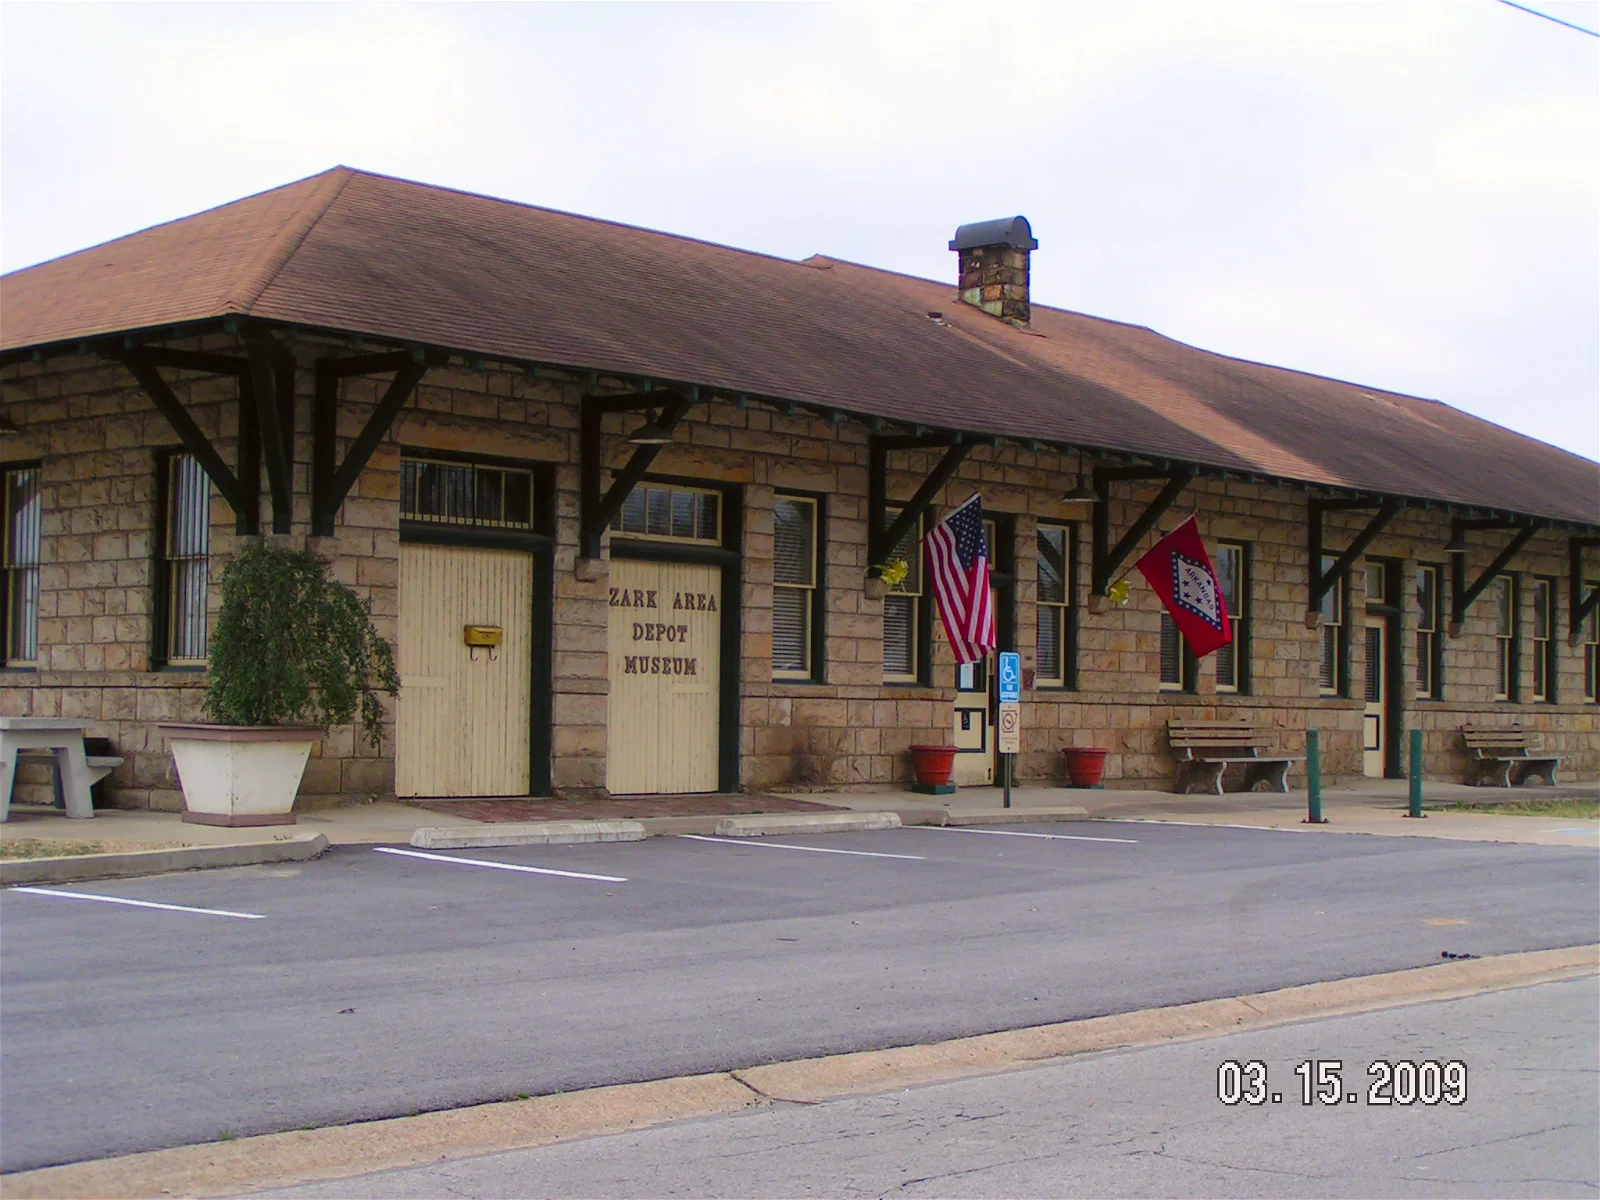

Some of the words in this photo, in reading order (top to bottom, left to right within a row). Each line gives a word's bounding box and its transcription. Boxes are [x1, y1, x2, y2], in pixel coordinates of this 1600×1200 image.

[673, 592, 717, 611] AREA
[632, 622, 688, 642] DEPOT
[624, 655, 697, 675] MUSEUM
